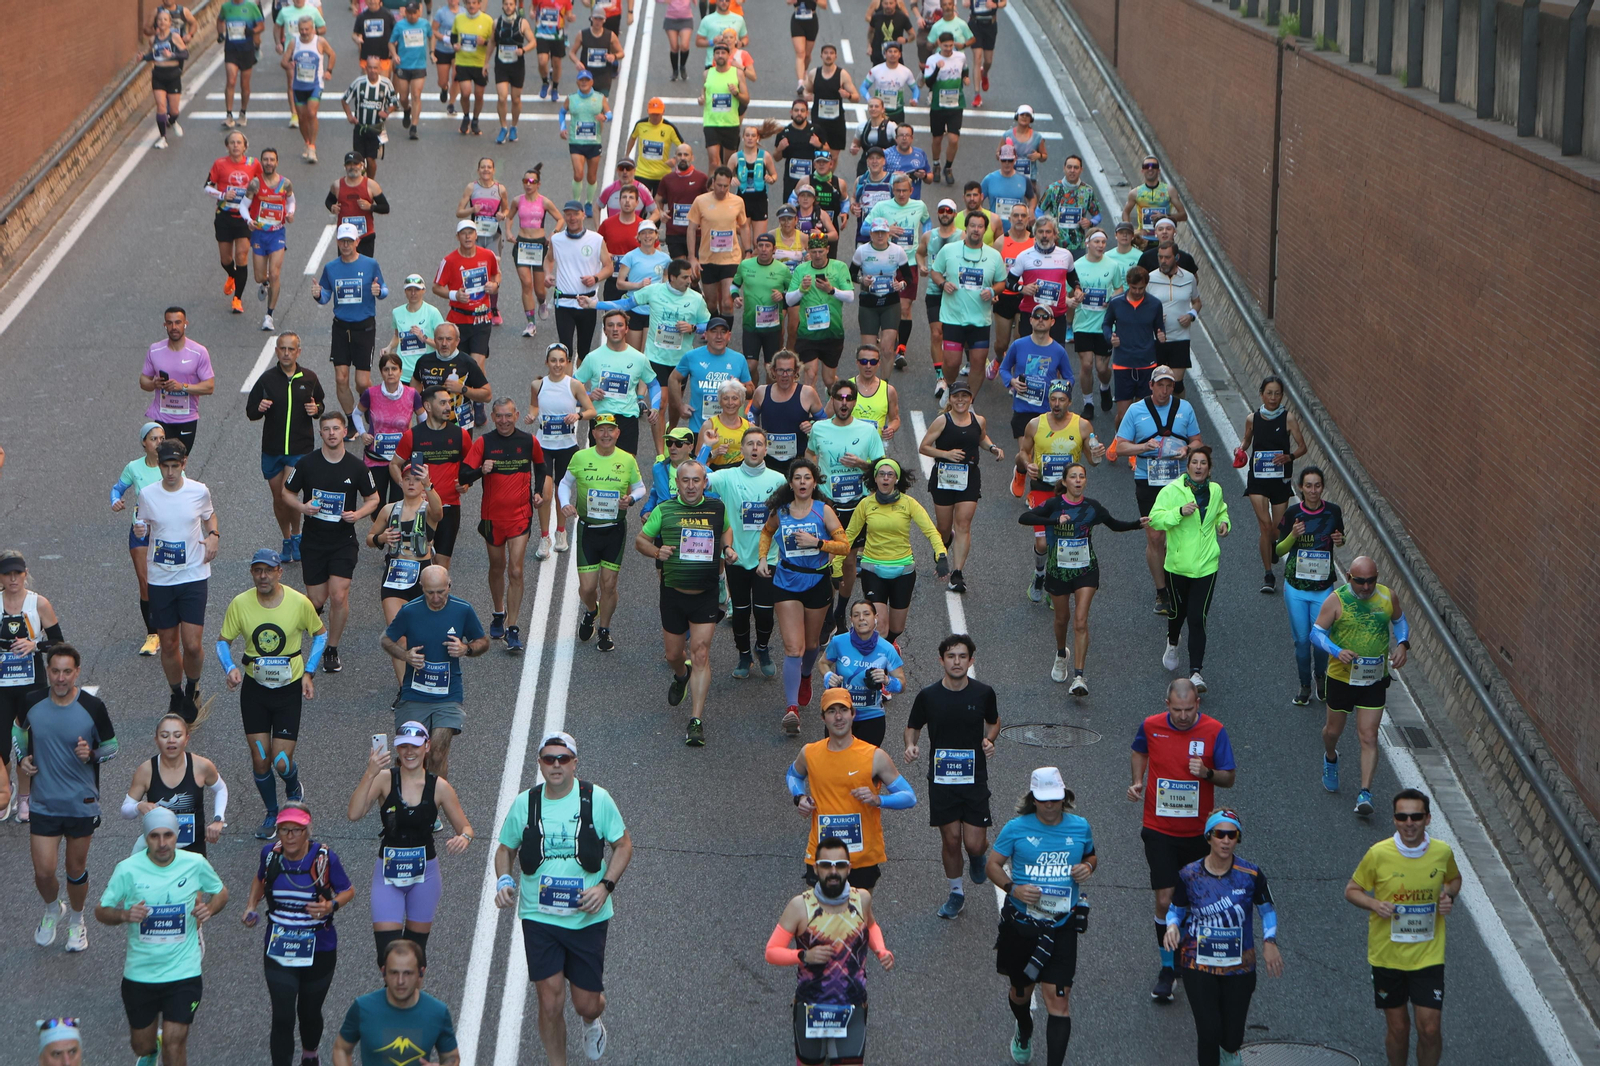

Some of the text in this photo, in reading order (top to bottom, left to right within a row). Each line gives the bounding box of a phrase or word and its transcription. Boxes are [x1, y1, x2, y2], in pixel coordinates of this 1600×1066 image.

[431, 367, 445, 376] CT
[1036, 852, 1069, 866] 42K
[1025, 865, 1072, 877] VALENCI
[1393, 893, 1434, 902] SEVILLA
[156, 907, 181, 915] ZURICH
